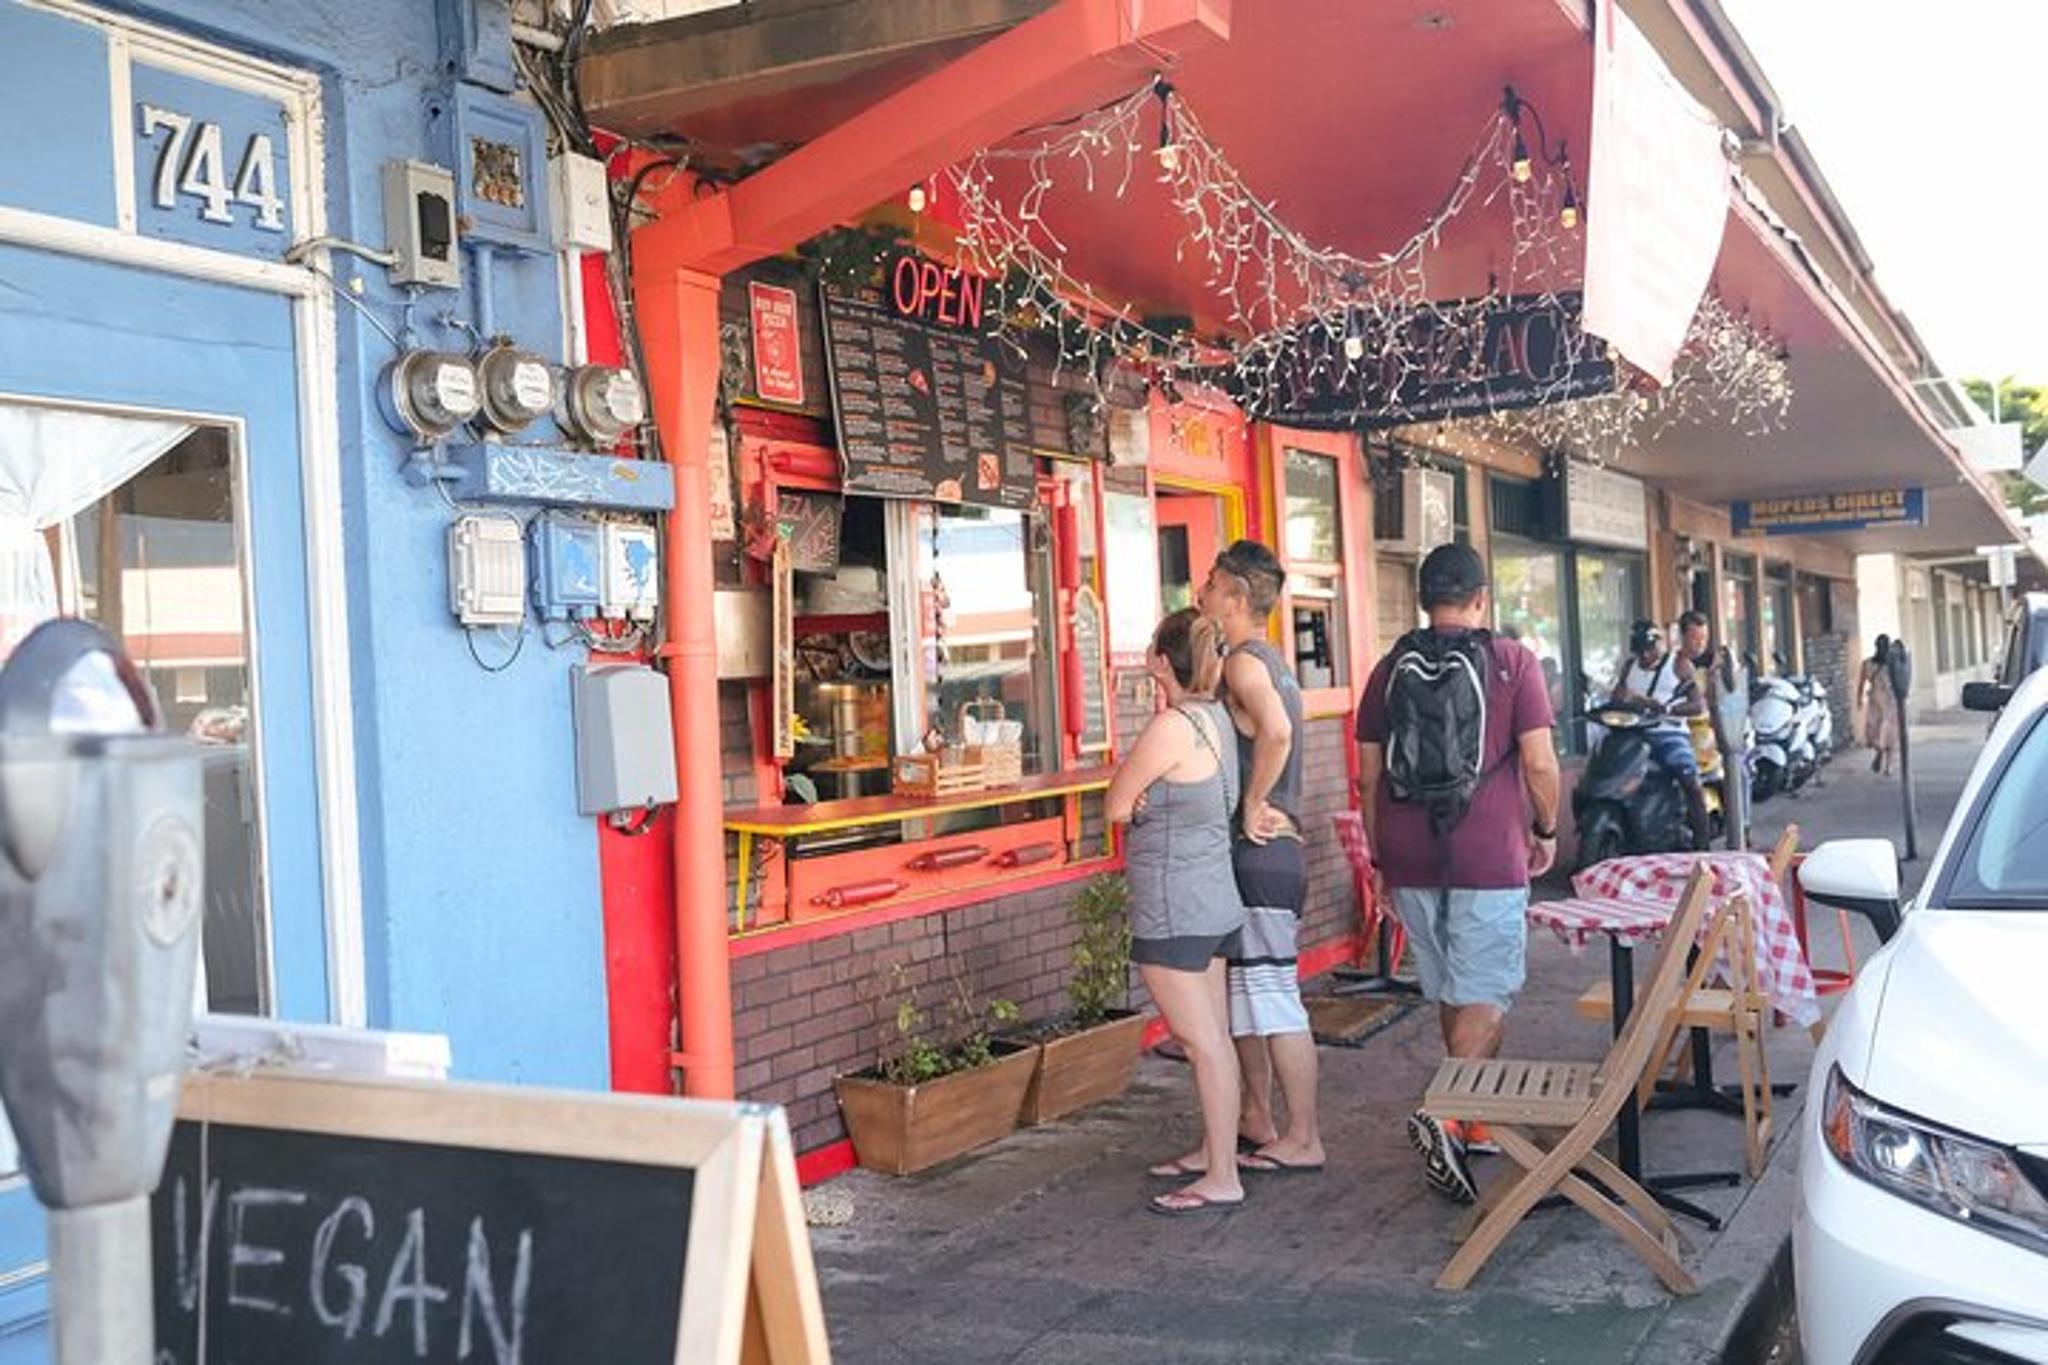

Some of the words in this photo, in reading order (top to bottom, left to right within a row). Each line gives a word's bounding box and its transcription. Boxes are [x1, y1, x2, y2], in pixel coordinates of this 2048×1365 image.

[140, 95, 285, 231] 744
[895, 256, 983, 329] OPEN
[1834, 490, 1906, 513] DIRECT
[174, 1174, 532, 1365] VEGAN
